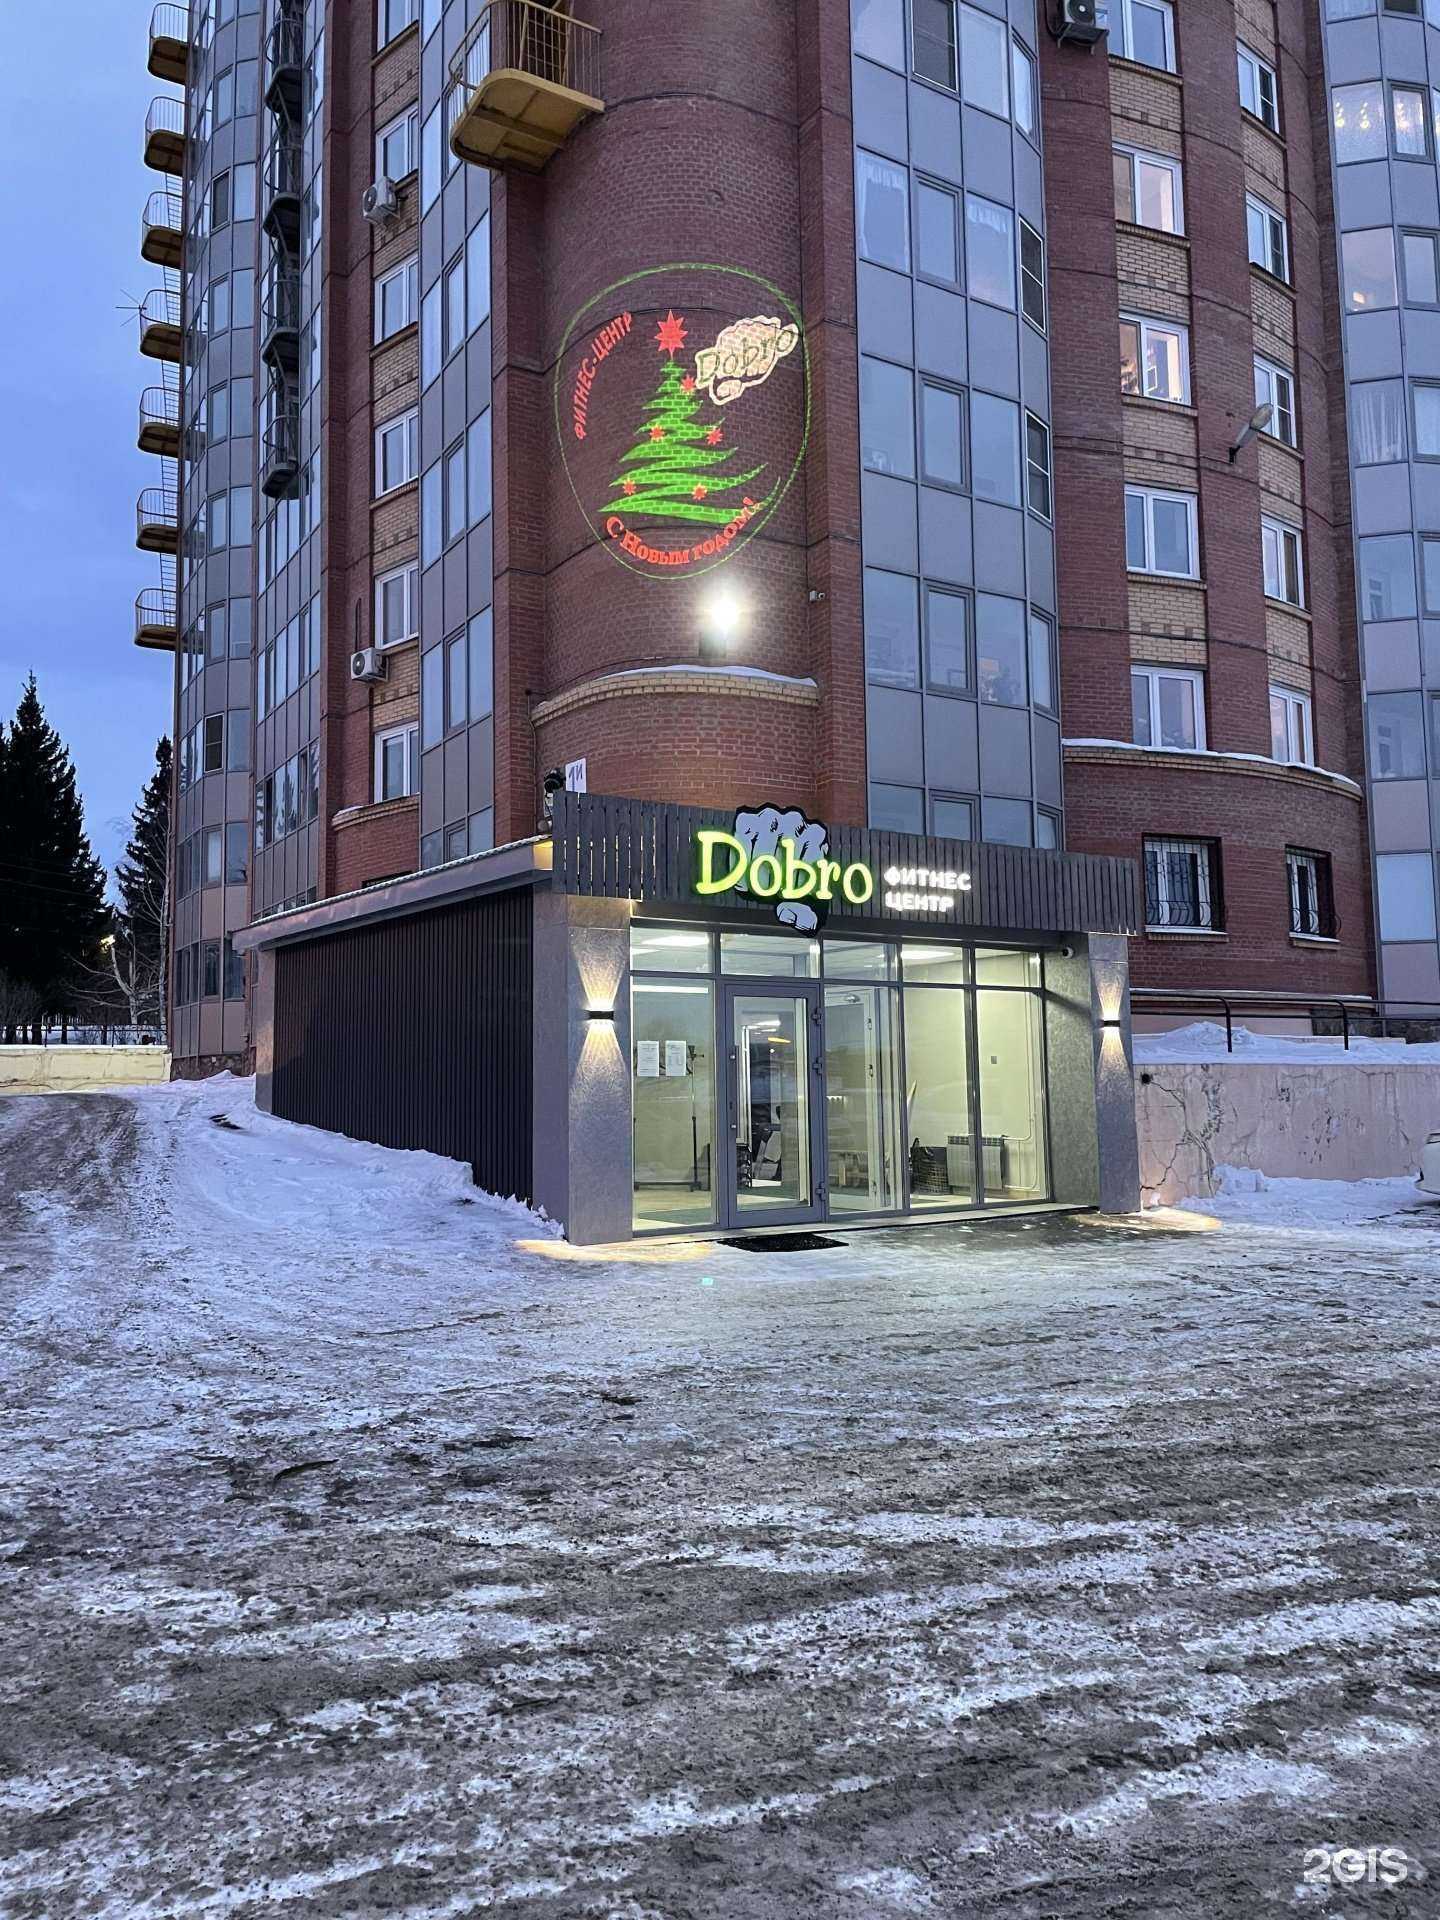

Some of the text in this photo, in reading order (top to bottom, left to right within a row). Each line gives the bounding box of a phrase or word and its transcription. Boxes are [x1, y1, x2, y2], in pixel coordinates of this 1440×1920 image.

[573, 311, 633, 440] ФИТНЕС-ЦЕНТР
[697, 329, 795, 385] Dobro
[696, 829, 873, 904] Dobro
[884, 866, 971, 890] ФИТНЕС
[885, 891, 954, 912] ЦЕНТР
